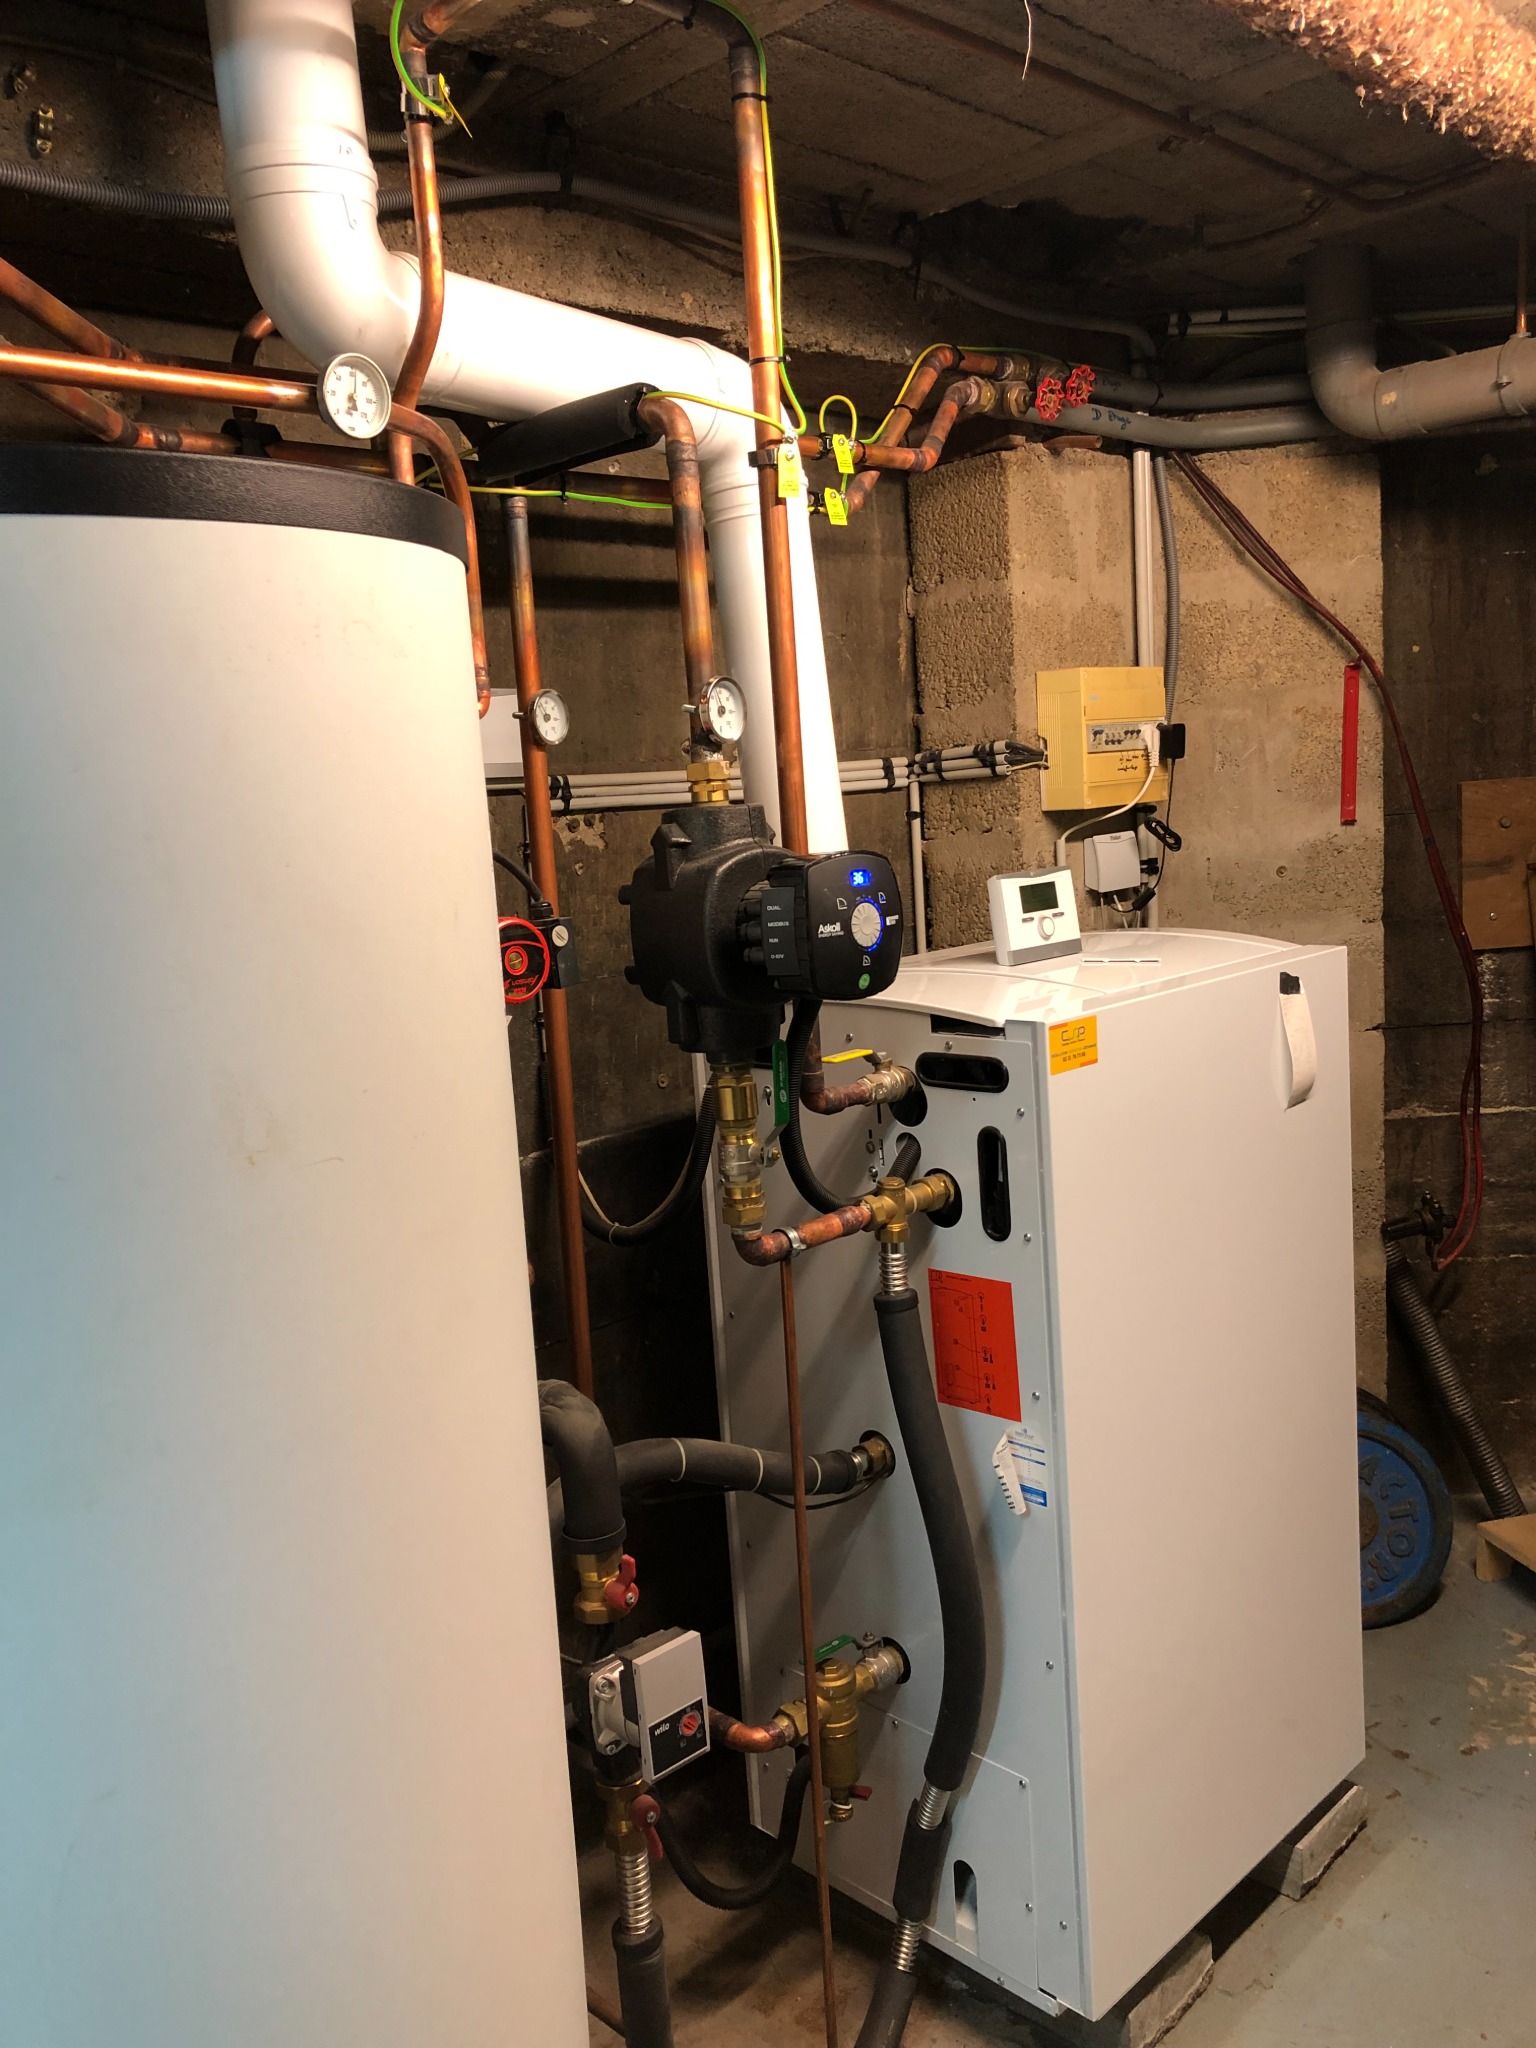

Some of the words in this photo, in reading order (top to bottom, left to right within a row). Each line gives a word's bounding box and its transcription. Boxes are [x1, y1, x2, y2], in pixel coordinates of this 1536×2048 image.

[853, 871, 864, 885] 36
[818, 922, 840, 934] Askoll
[654, 1723, 669, 1736] wilo
